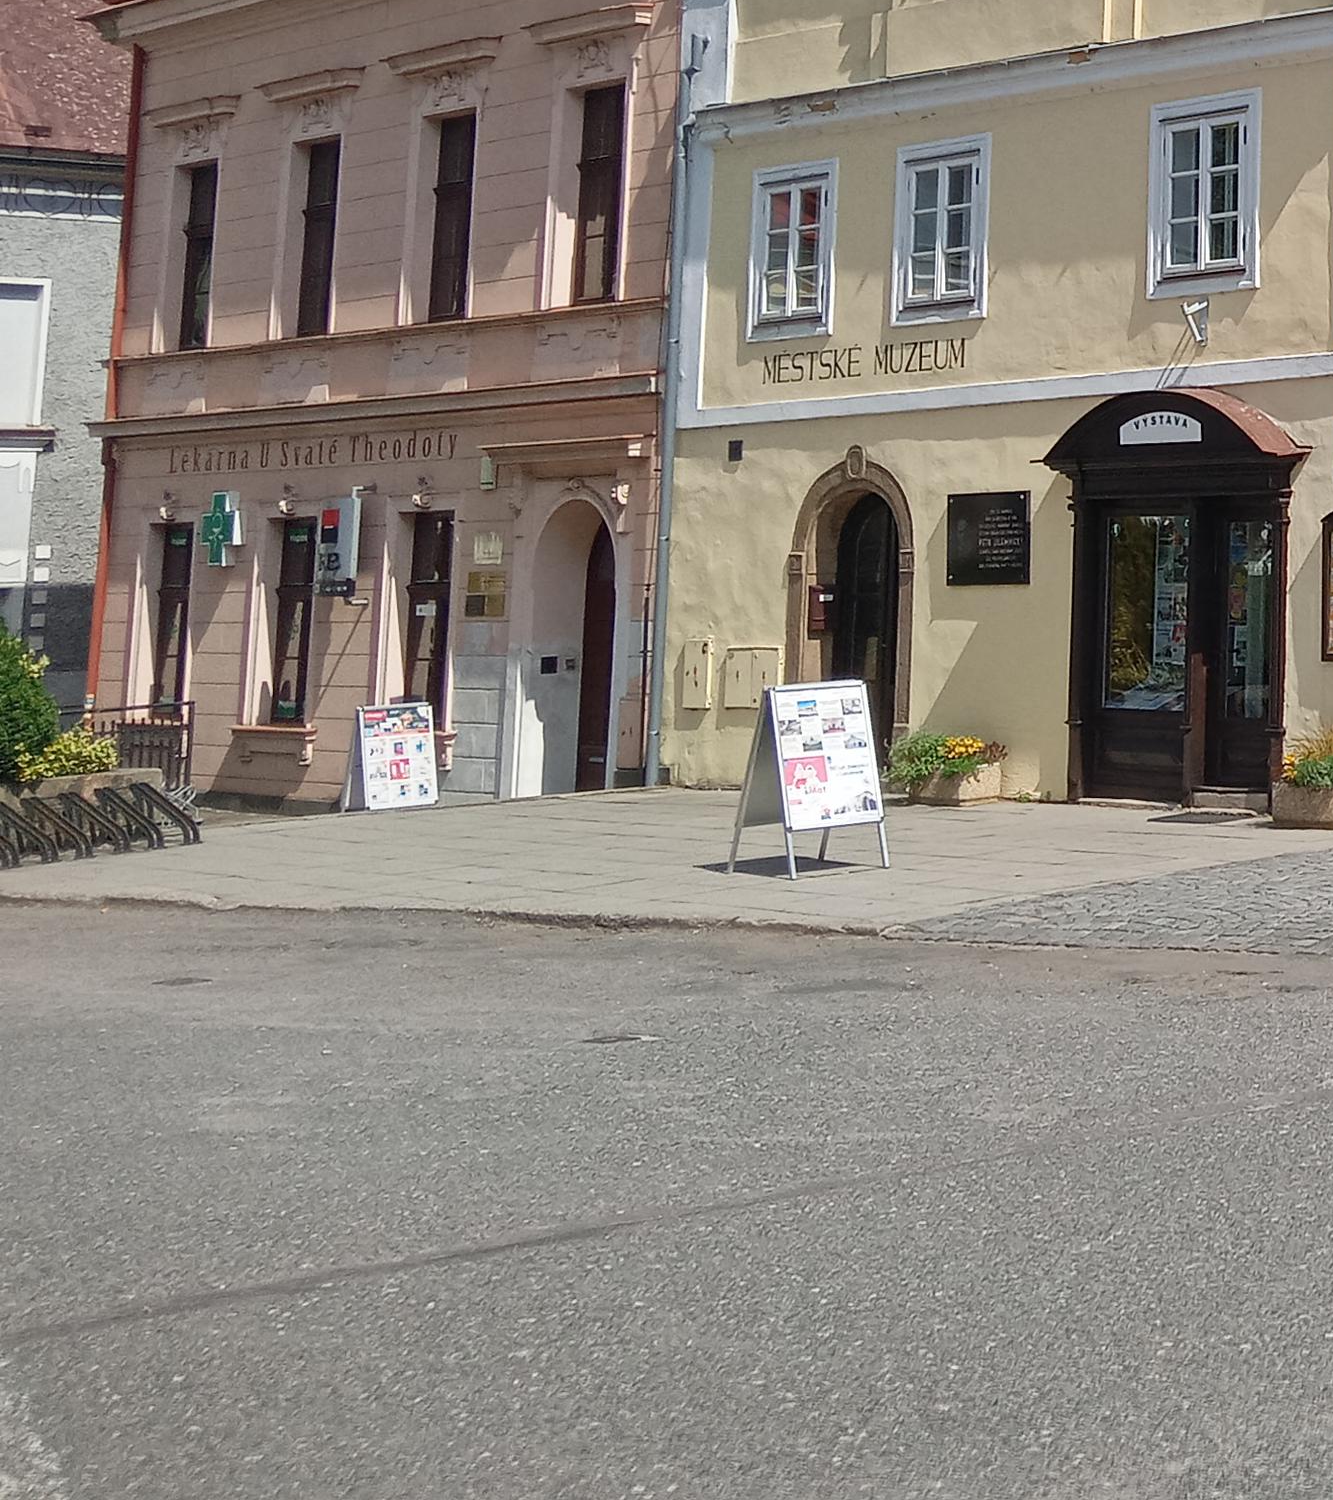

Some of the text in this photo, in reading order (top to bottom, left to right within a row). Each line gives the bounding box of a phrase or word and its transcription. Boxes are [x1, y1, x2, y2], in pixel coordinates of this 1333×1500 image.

[762, 337, 966, 385] MĚSTSKÉ MUZEUM
[260, 442, 271, 468] U
[280, 439, 338, 468] Svaté
[350, 429, 458, 463] Theodoty
